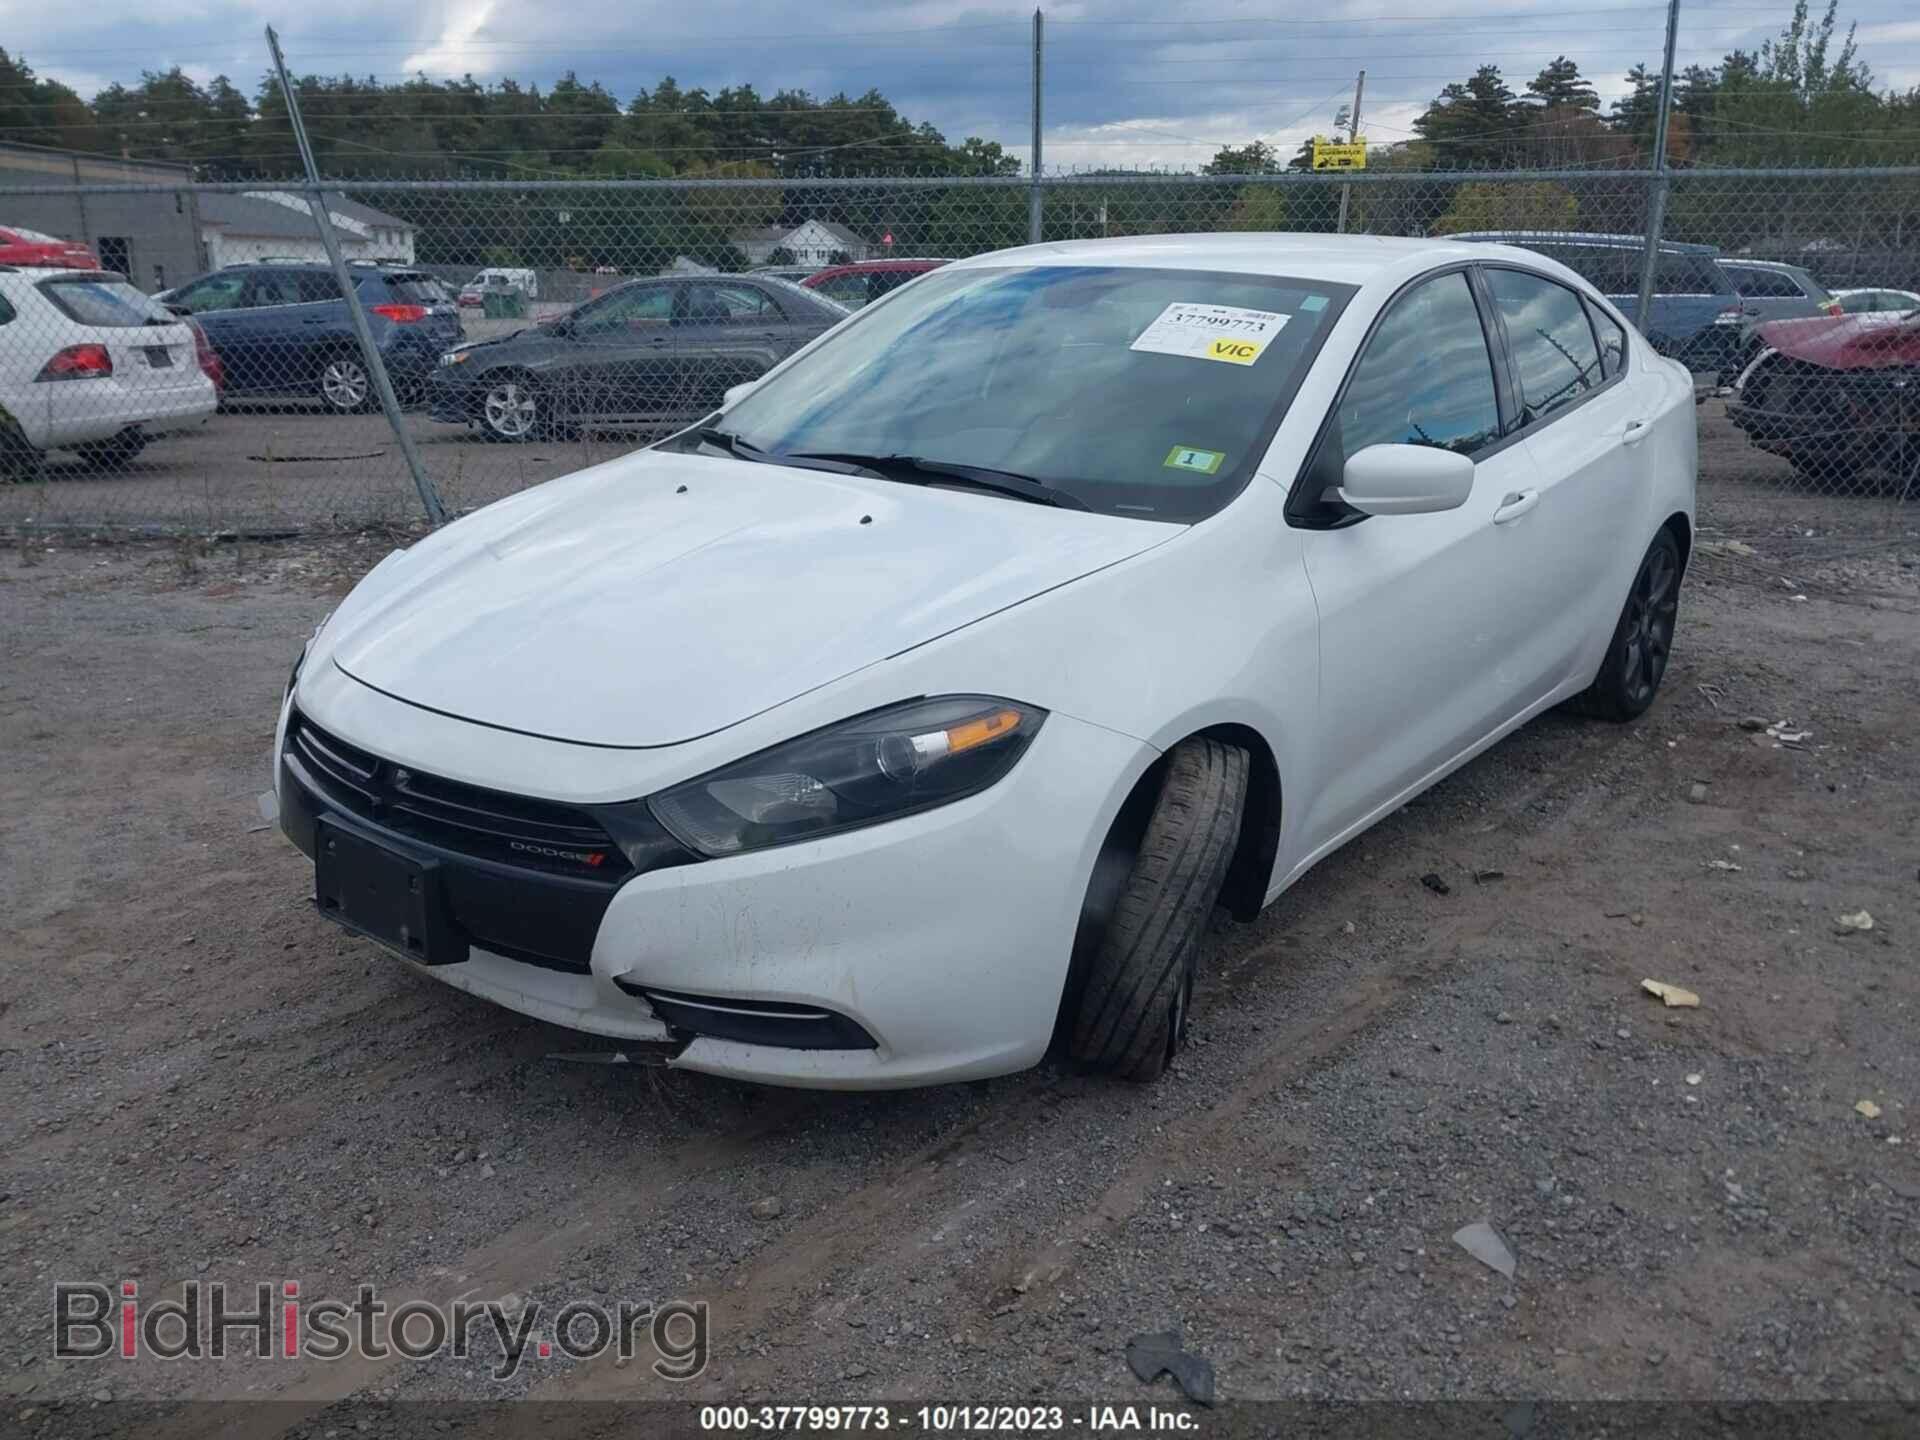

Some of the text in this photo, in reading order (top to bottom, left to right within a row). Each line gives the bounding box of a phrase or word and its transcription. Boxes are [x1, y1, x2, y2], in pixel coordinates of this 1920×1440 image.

[1168, 313, 1267, 333] 37799773
[1216, 342, 1255, 357] VIC
[1182, 452, 1195, 465] 1
[510, 841, 590, 863] DODGE
